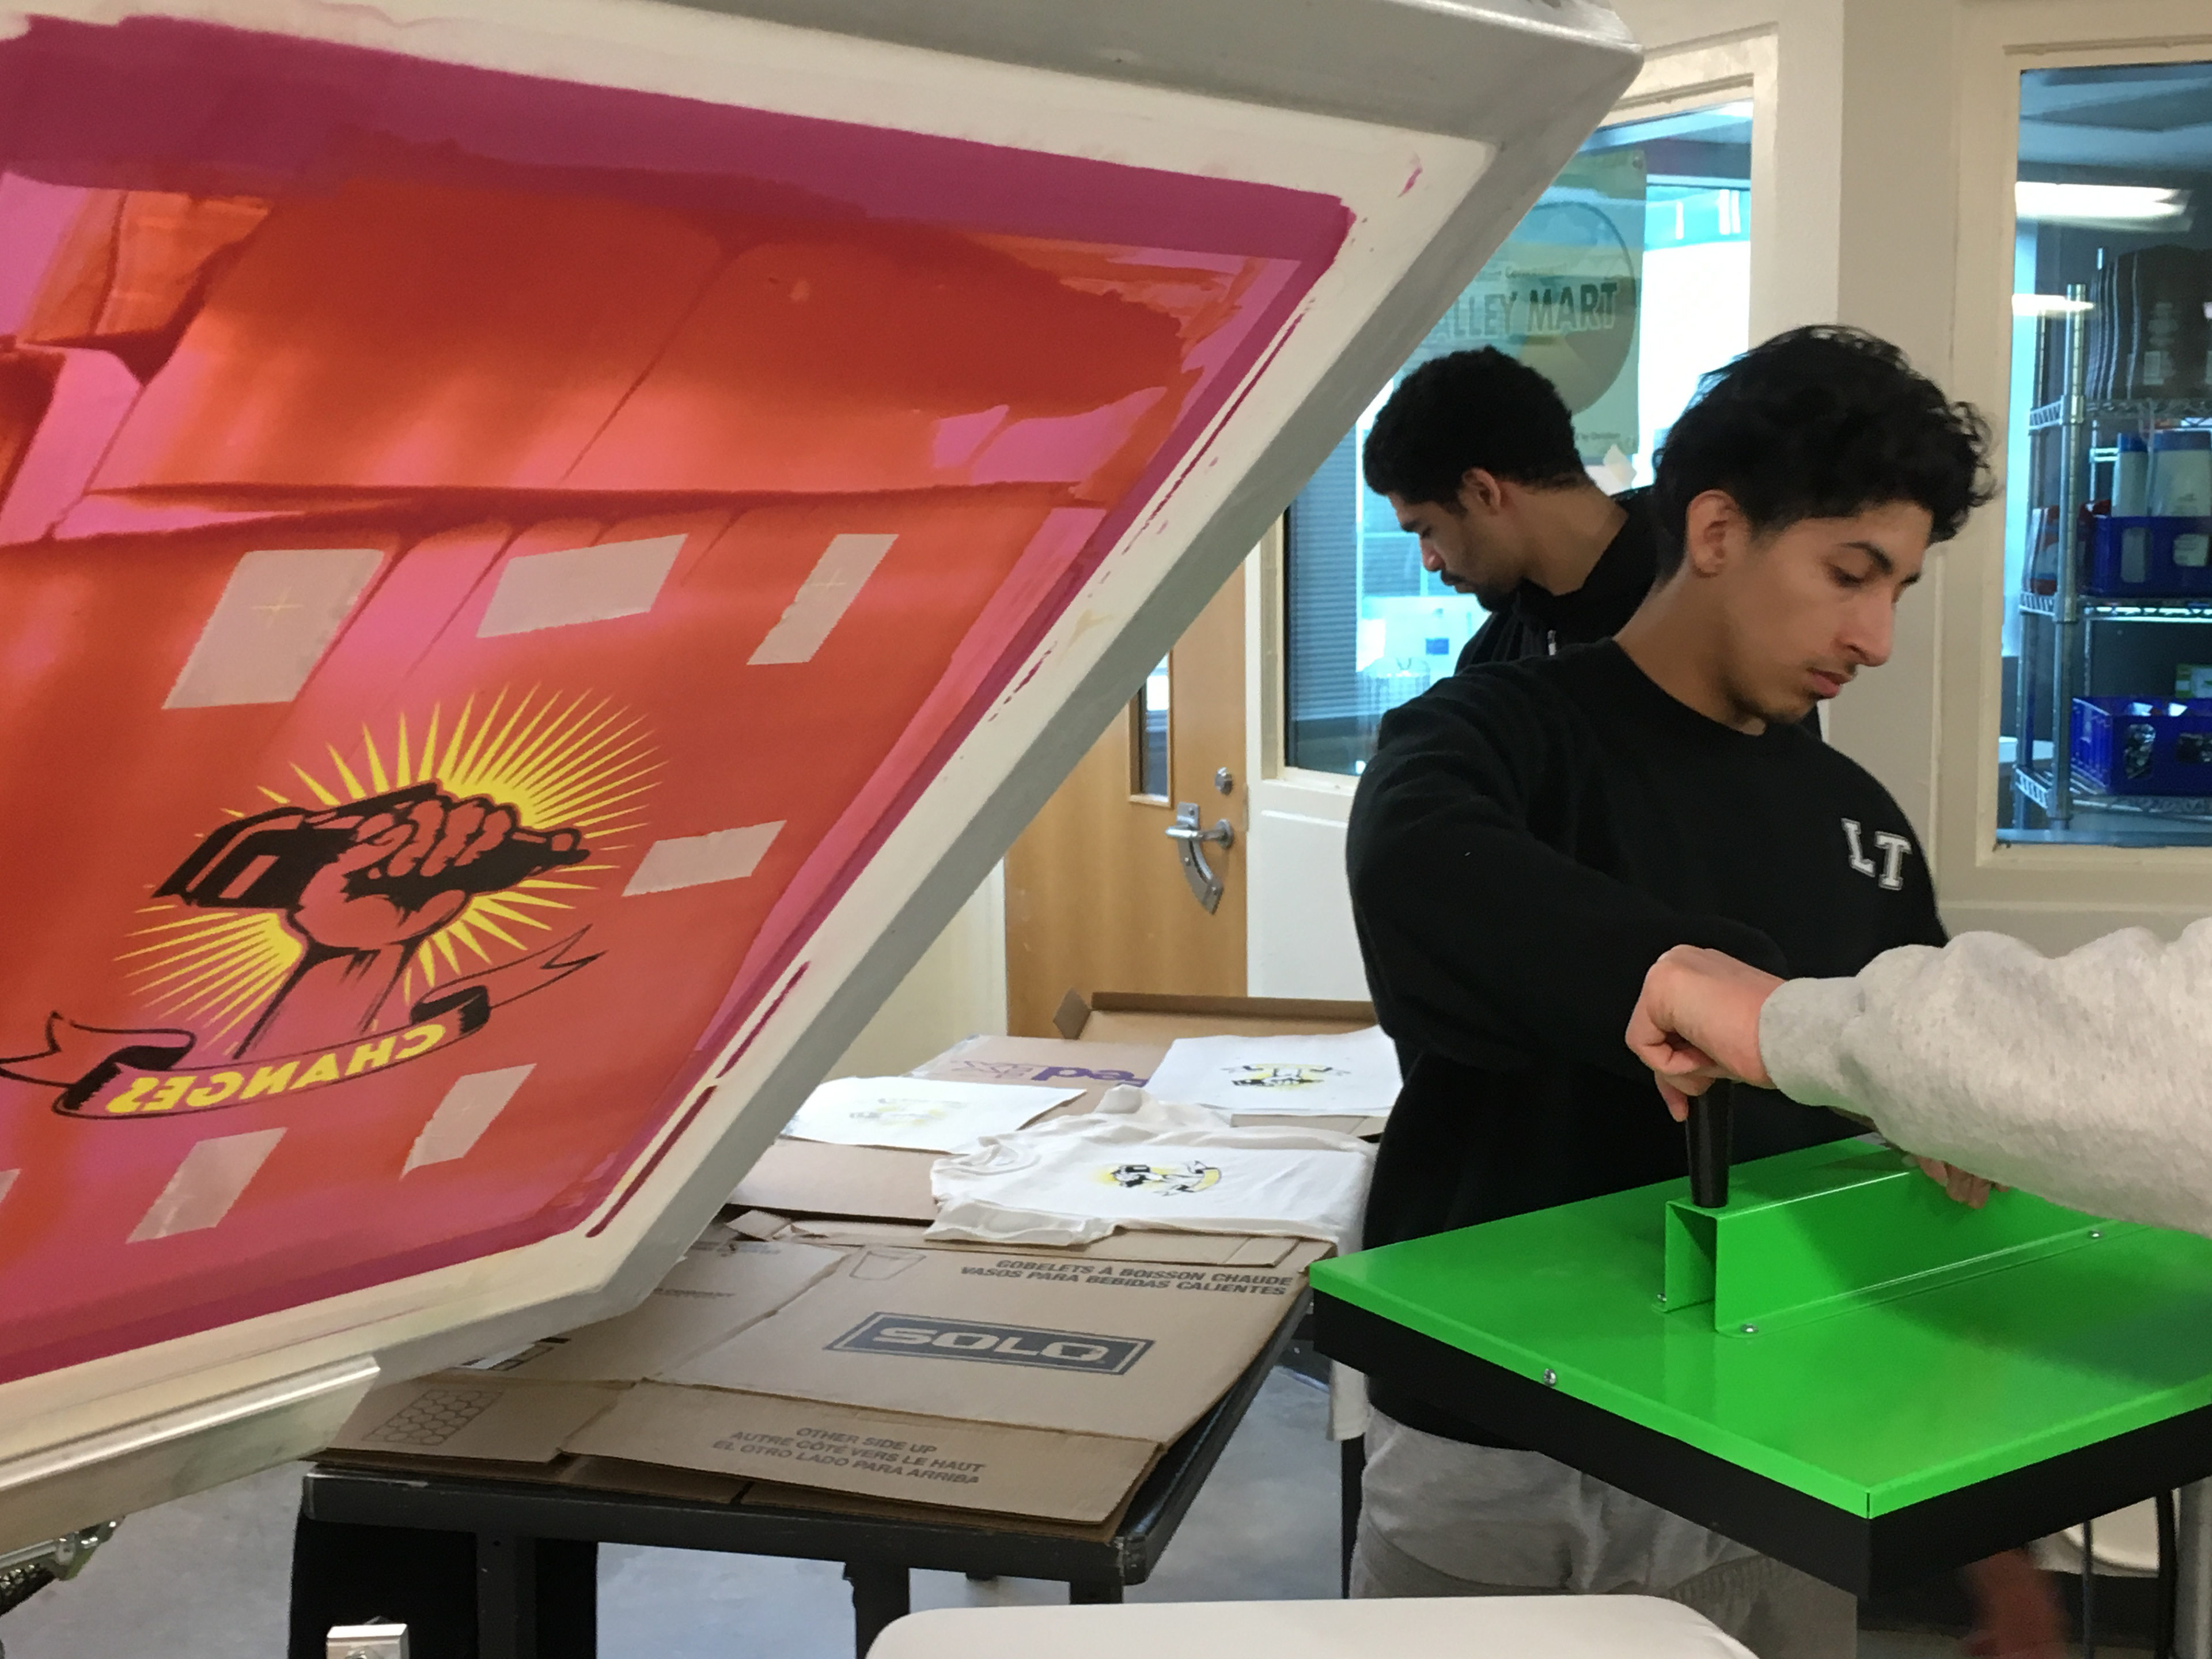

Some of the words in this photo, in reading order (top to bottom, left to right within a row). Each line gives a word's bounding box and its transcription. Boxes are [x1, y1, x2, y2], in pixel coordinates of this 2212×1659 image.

[1527, 282, 1618, 332] MART
[1841, 817, 1912, 891] LT
[961, 1266, 1023, 1278] VASOS
[1026, 1271, 1079, 1282] PARA
[1085, 1275, 1171, 1288] BEBIDAS
[1177, 1281, 1286, 1295] CALIENTES
[996, 1259, 1095, 1274] GOBELETS
[1119, 1268, 1206, 1281] BOISSON
[1211, 1273, 1293, 1286] CHAUDE
[873, 1327, 1109, 1361] SOLO
[730, 1431, 794, 1446] AUTRE
[851, 1447, 899, 1462] VERS
[902, 1455, 928, 1466] LE
[930, 1459, 986, 1472] HAUT
[796, 1427, 859, 1443] OTHER
[862, 1437, 908, 1450] SIDE
[909, 1444, 938, 1454] UP
[713, 1440, 734, 1451] EL
[740, 1444, 793, 1458] OTRO
[796, 1452, 850, 1467] LADO
[852, 1460, 903, 1475] PARA
[906, 1468, 979, 1484] ARRIBA
